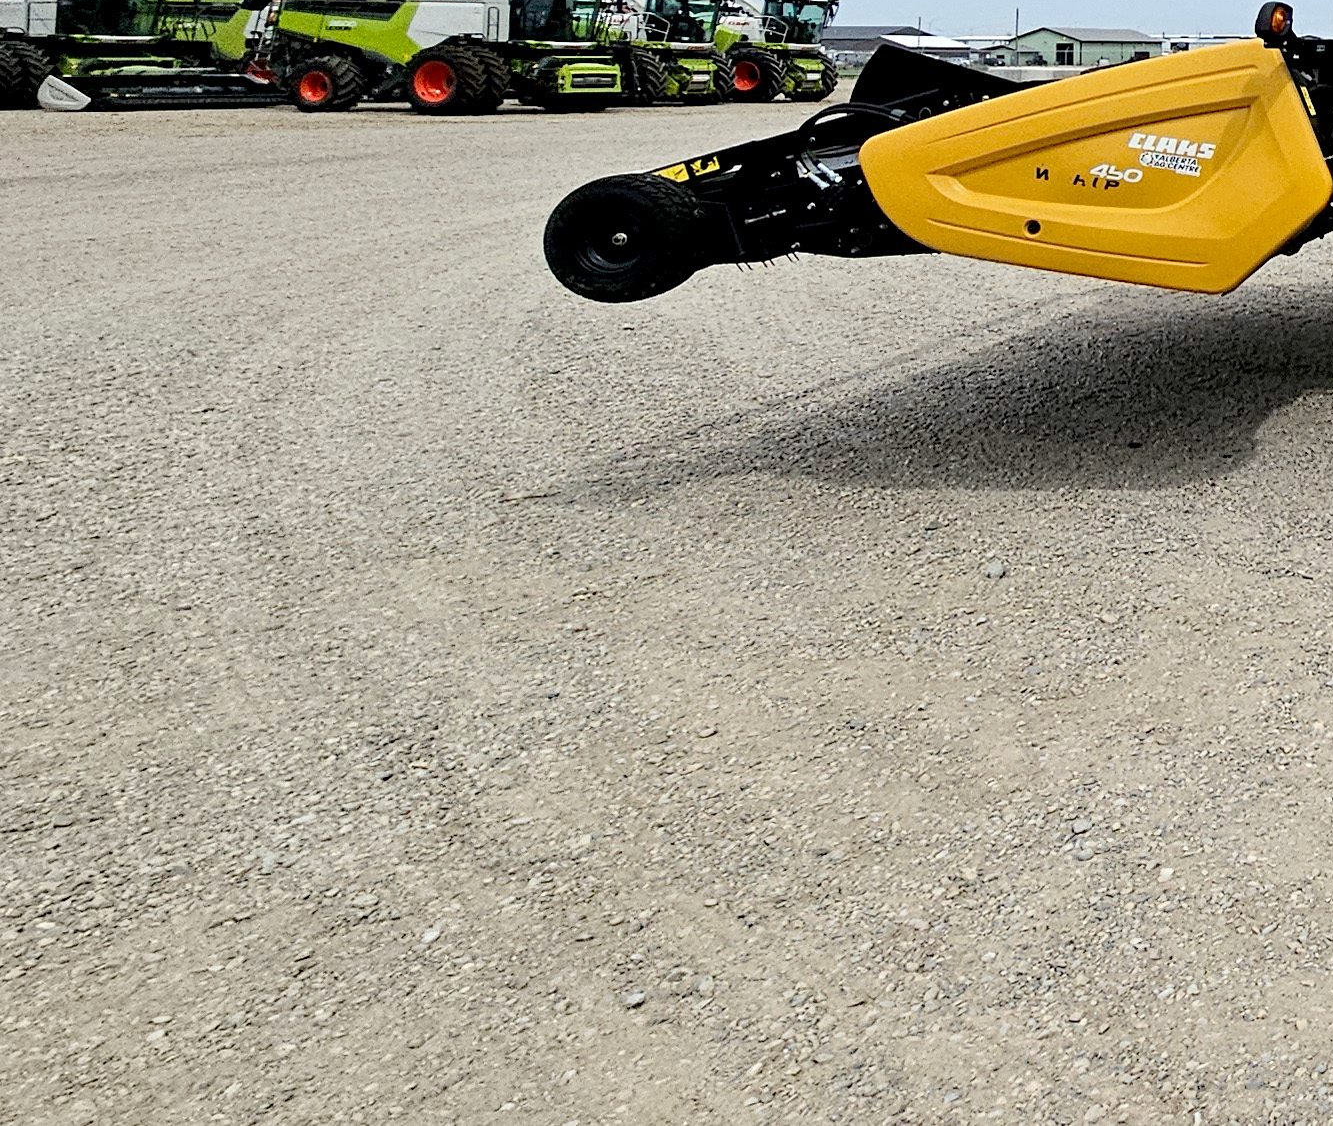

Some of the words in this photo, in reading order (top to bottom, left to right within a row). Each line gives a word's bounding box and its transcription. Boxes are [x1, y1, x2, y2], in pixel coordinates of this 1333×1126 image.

[1128, 132, 1217, 160] CLAAS
[1158, 154, 1198, 166] ALBERTA
[1167, 162, 1200, 173] CENTRE
